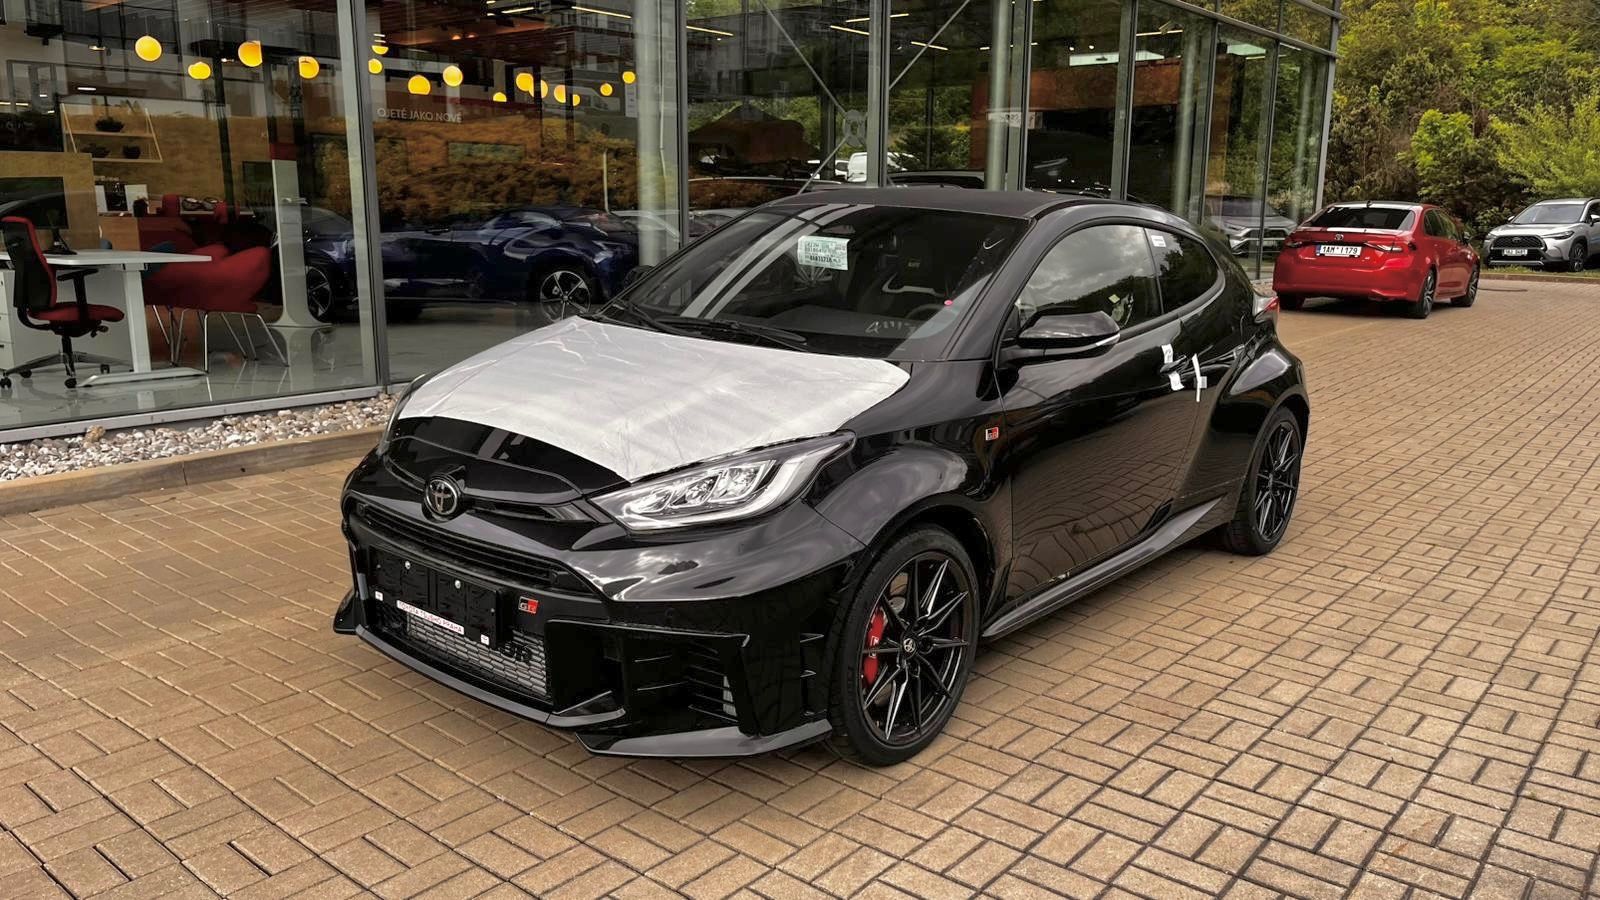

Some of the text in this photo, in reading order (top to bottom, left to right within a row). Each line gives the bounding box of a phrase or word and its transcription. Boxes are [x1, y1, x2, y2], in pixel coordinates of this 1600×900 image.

[409, 110, 433, 121] JAKO
[436, 111, 463, 123] NOVÉ
[399, 601, 420, 616] TOYOTA
[443, 618, 463, 633] PRAHA
